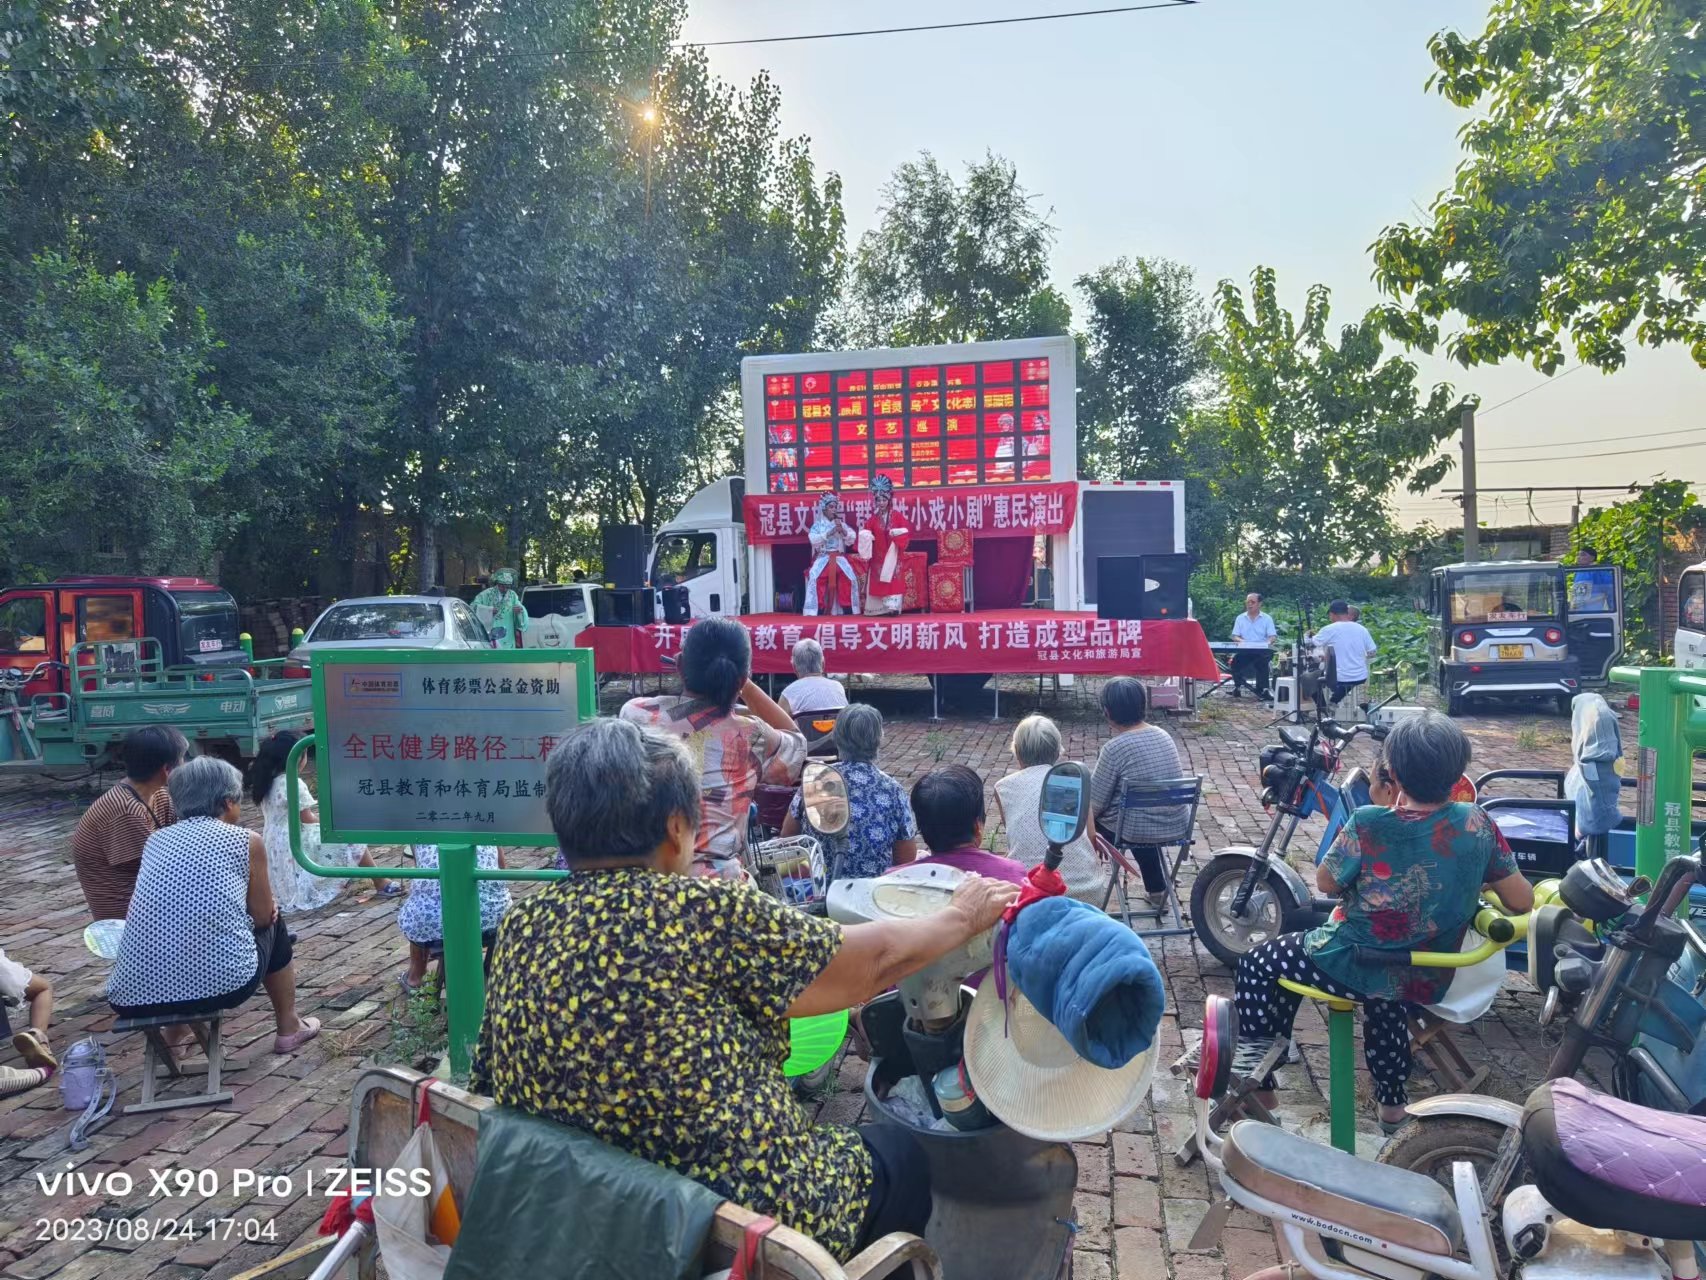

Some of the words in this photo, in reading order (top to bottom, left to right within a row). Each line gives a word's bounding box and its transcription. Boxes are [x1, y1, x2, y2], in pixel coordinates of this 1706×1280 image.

[814, 621, 967, 651] 倡导文明新风
[978, 619, 1143, 650] 打造成型品牌
[1037, 647, 1142, 661] 冠县文化和旅游局宣
[422, 677, 560, 695] 体育彩票公益金资助
[220, 700, 245, 713] 电动
[343, 732, 562, 762] 全民健身路径工程
[358, 778, 546, 799] 冠县教育和体育局监制
[416, 811, 495, 823] 二零二二年九月
[1291, 1212, 1373, 1245] www.bodocn.com
